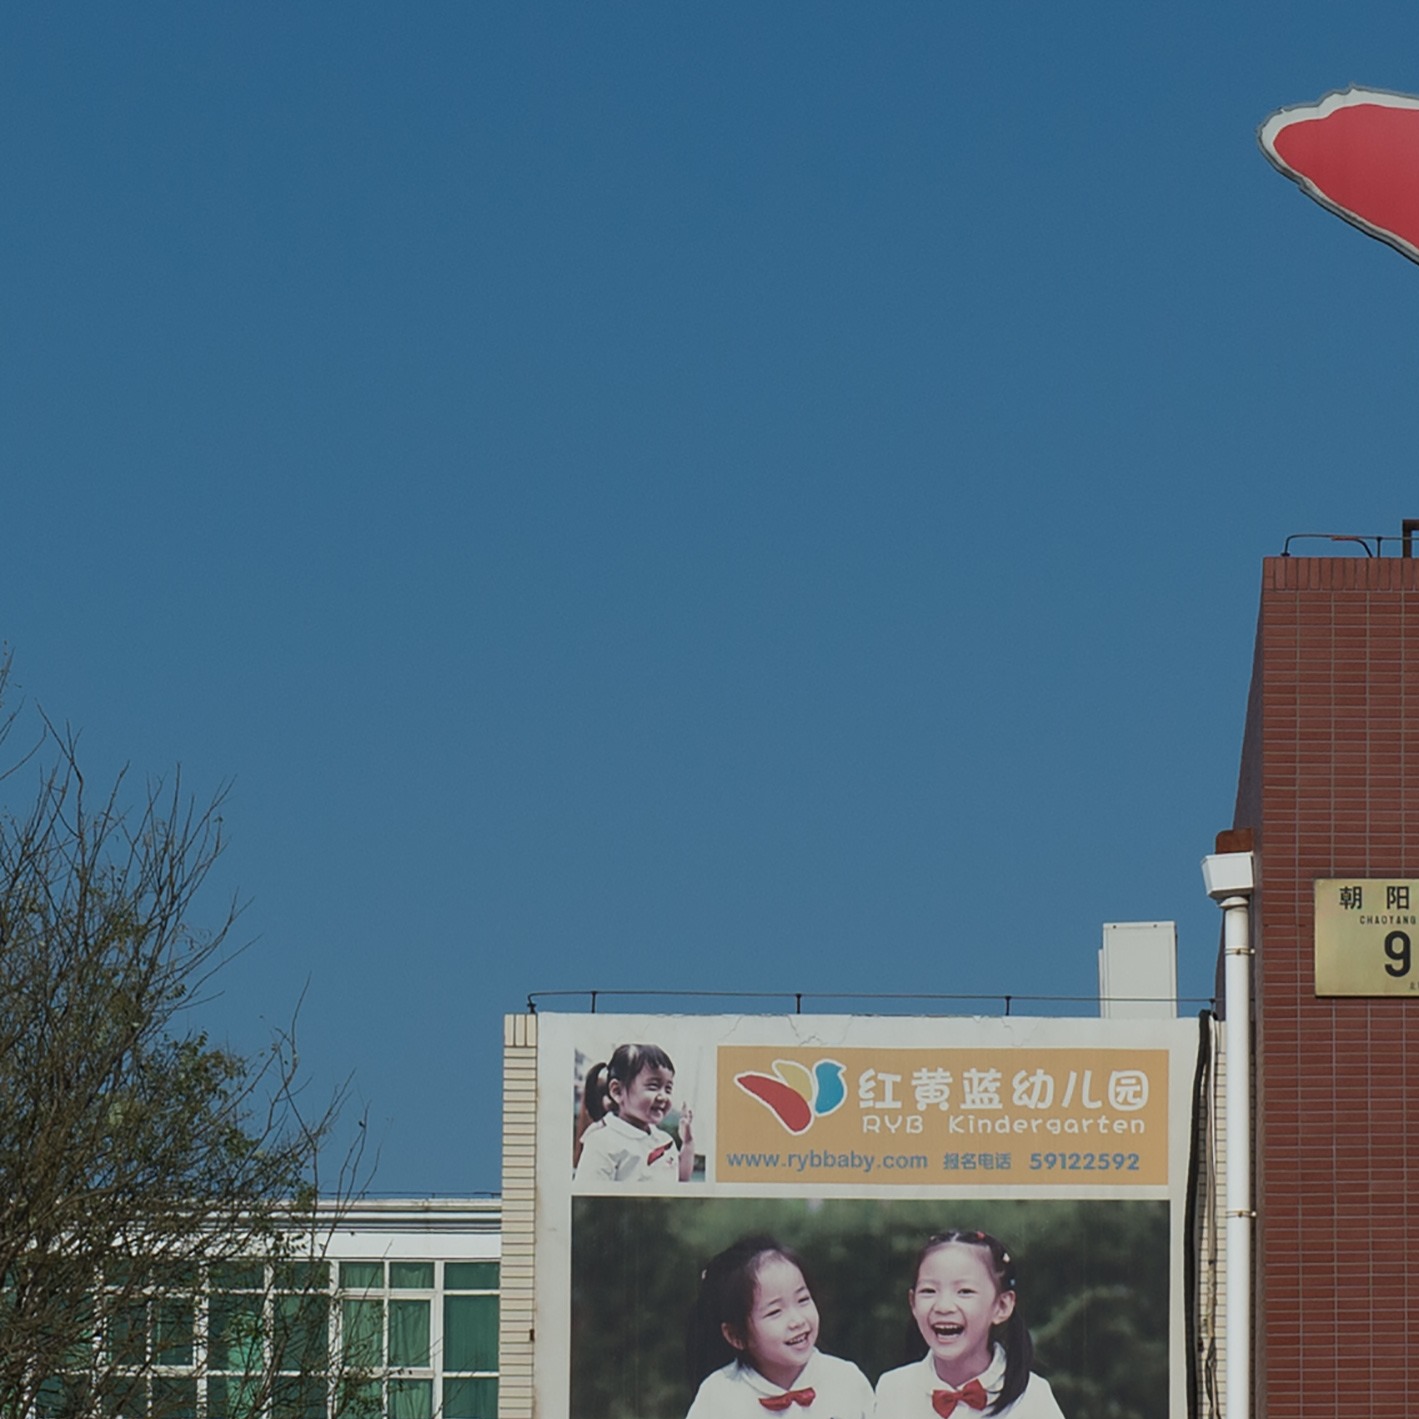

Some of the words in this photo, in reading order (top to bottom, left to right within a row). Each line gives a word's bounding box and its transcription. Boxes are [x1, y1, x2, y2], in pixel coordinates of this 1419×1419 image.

[1359, 915, 1416, 925] CHAOYANG
[1384, 930, 1411, 978] 9
[858, 1067, 1150, 1112] 红黄蓝幼儿园
[862, 1114, 924, 1134] RYB
[949, 1114, 1145, 1135] Kindergarten
[727, 1150, 929, 1172] www.rybbaby.com
[943, 1152, 1012, 1171] 报名电话
[1029, 1152, 1140, 1171] 59122592
